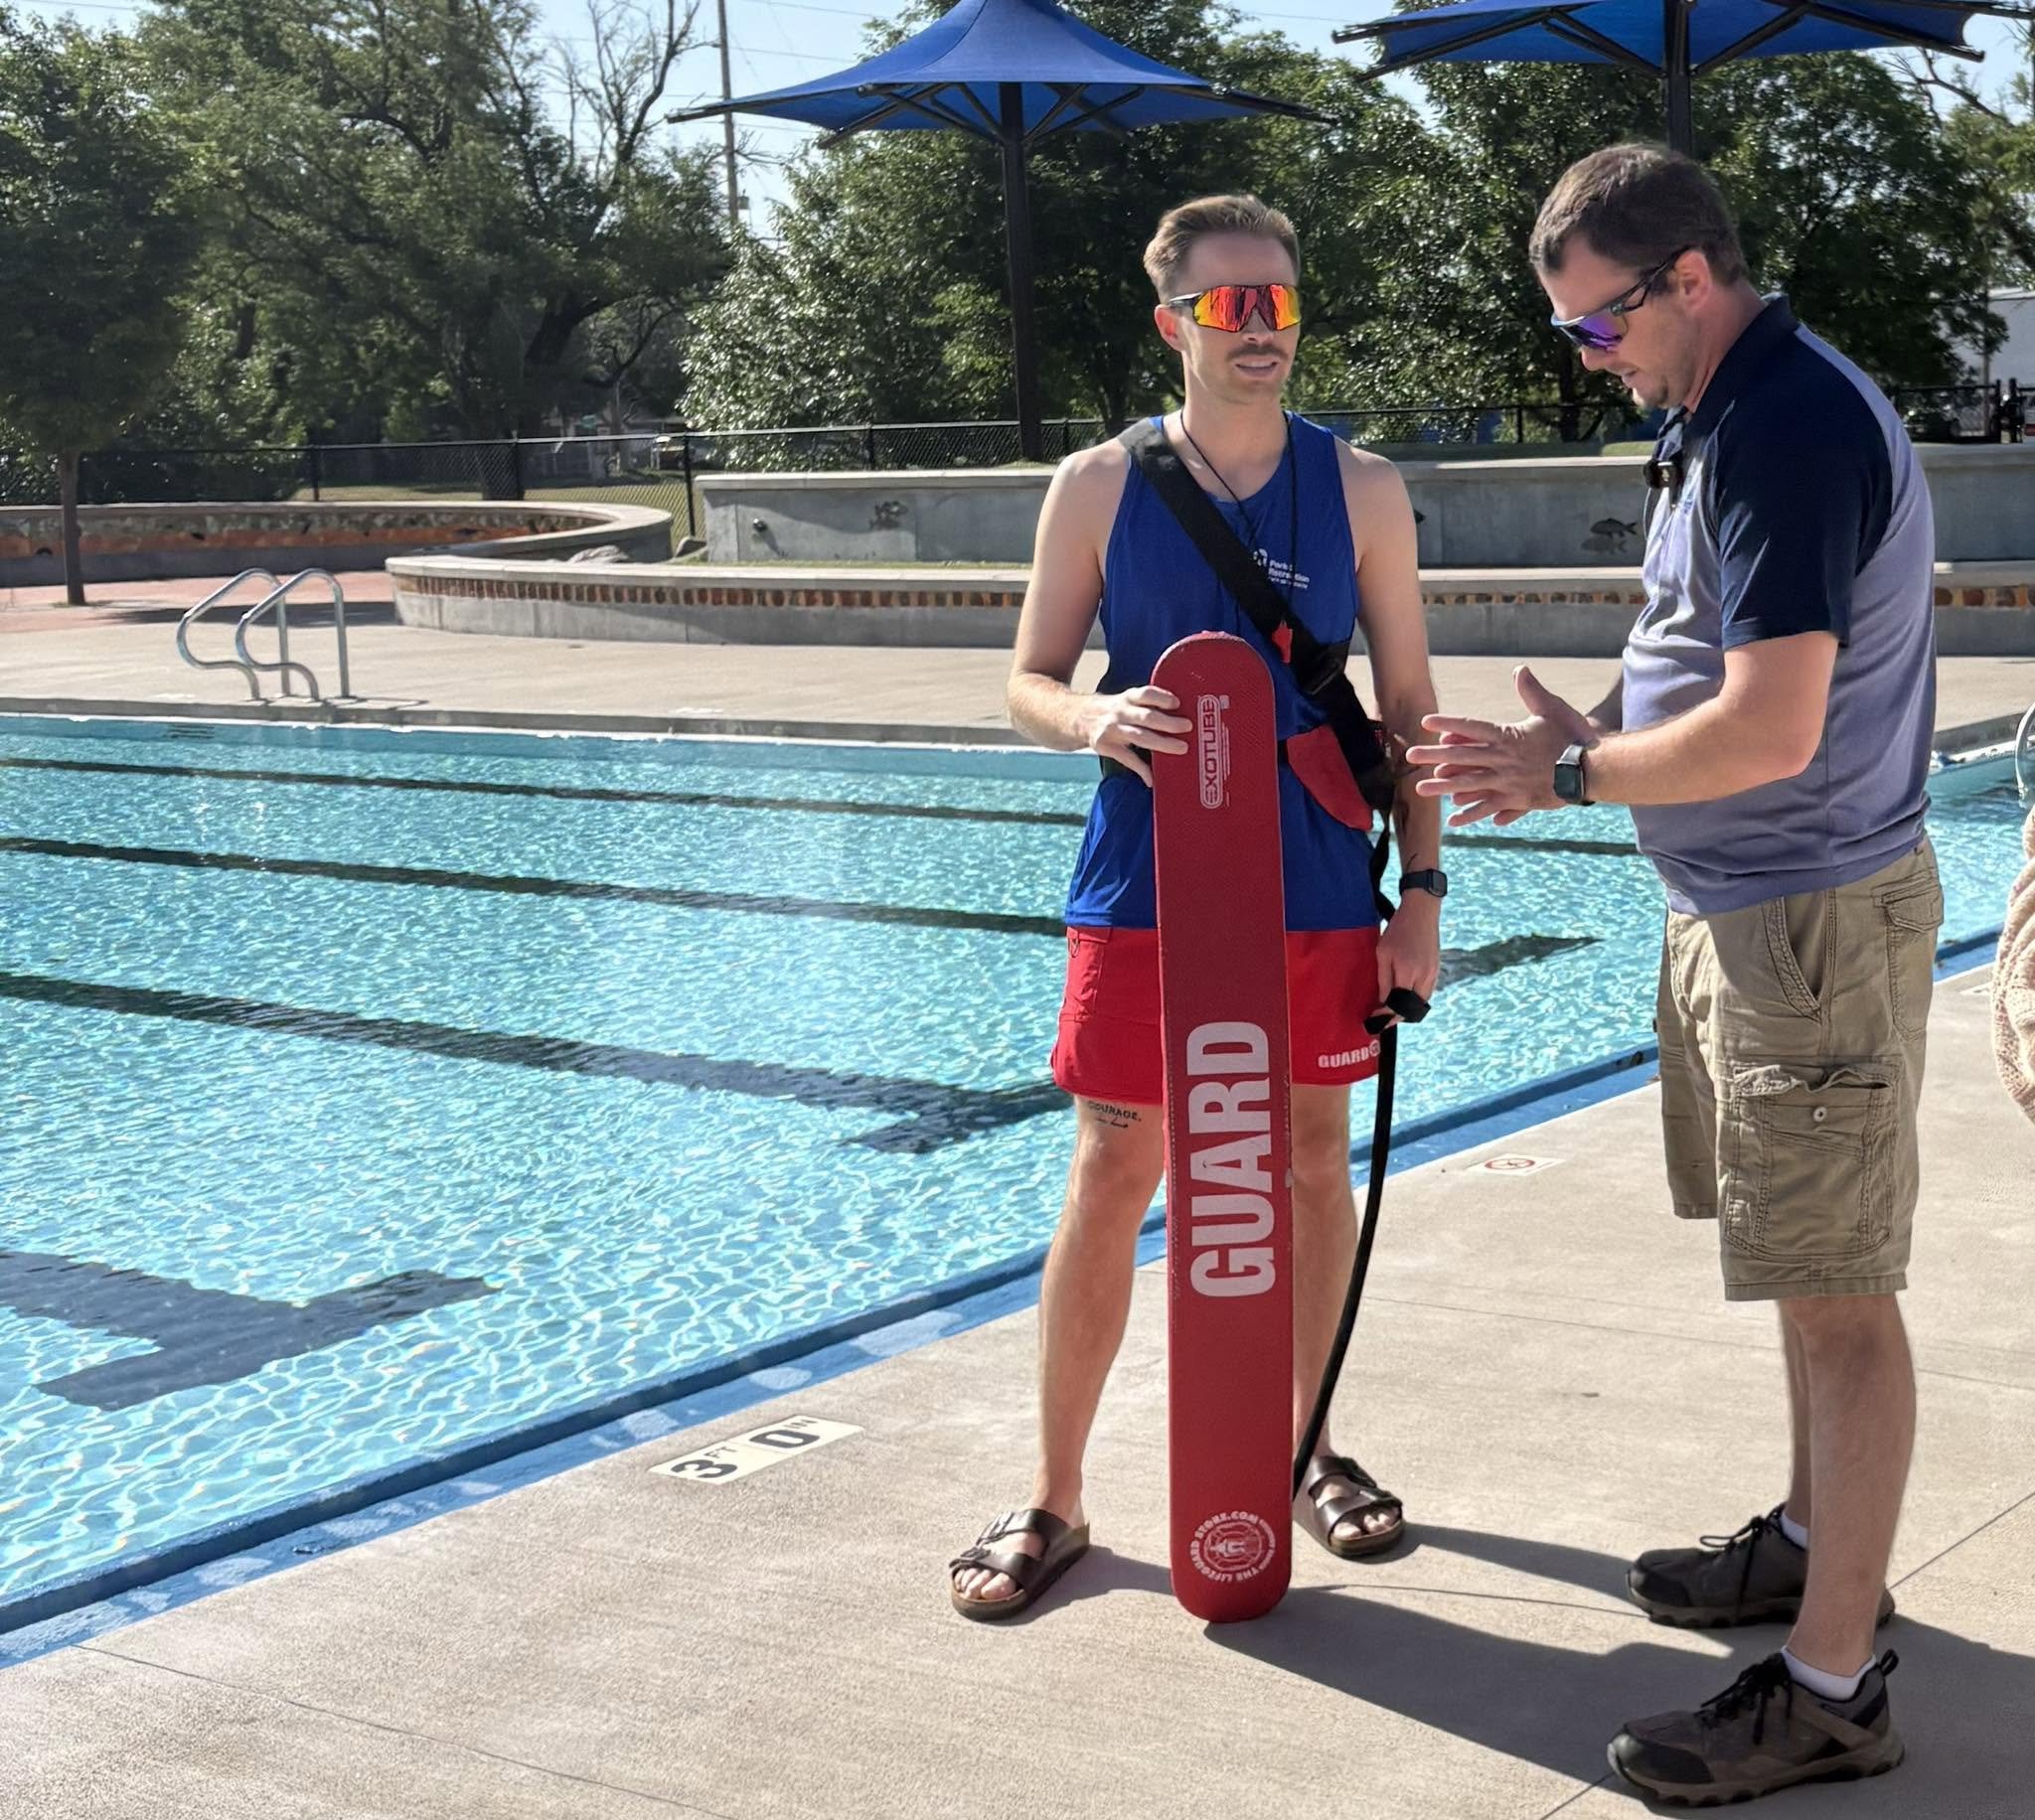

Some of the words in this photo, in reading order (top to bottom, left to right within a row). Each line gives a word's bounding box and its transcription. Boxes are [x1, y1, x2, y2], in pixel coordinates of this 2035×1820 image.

[1202, 699, 1218, 805] EXOTUBE
[1318, 1046, 1369, 1068] GUARD
[1186, 1021, 1276, 1296] GUARD
[672, 1459, 738, 1478] 3
[705, 1446, 737, 1458] FT
[749, 1430, 820, 1448] 0
